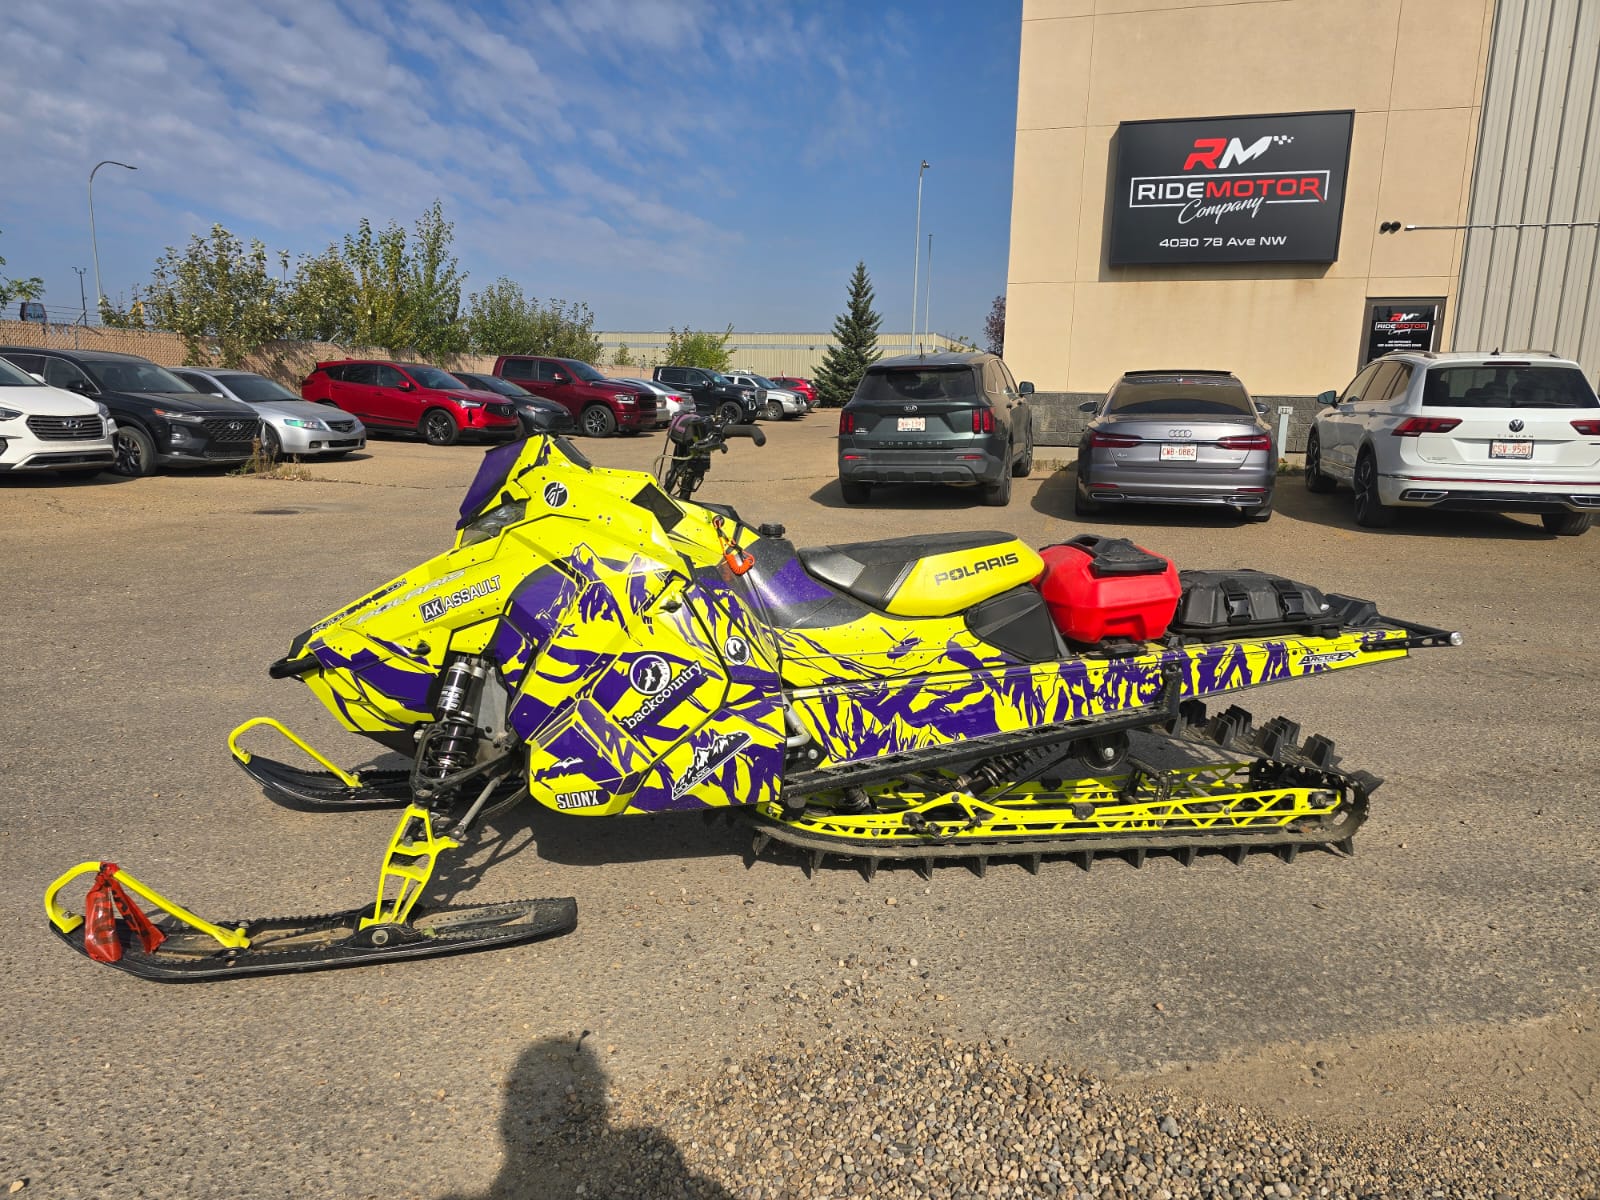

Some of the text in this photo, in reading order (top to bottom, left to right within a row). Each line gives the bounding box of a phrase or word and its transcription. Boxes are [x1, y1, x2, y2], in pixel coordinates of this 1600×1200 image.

[1184, 136, 1272, 170] RM
[1178, 195, 1265, 225] Company
[1159, 235, 1287, 248] 4030 78 Ave NW
[934, 552, 1020, 586] POLARIS
[422, 599, 446, 623] AK
[443, 575, 501, 611] ASSAULT
[621, 661, 704, 729] backcountry
